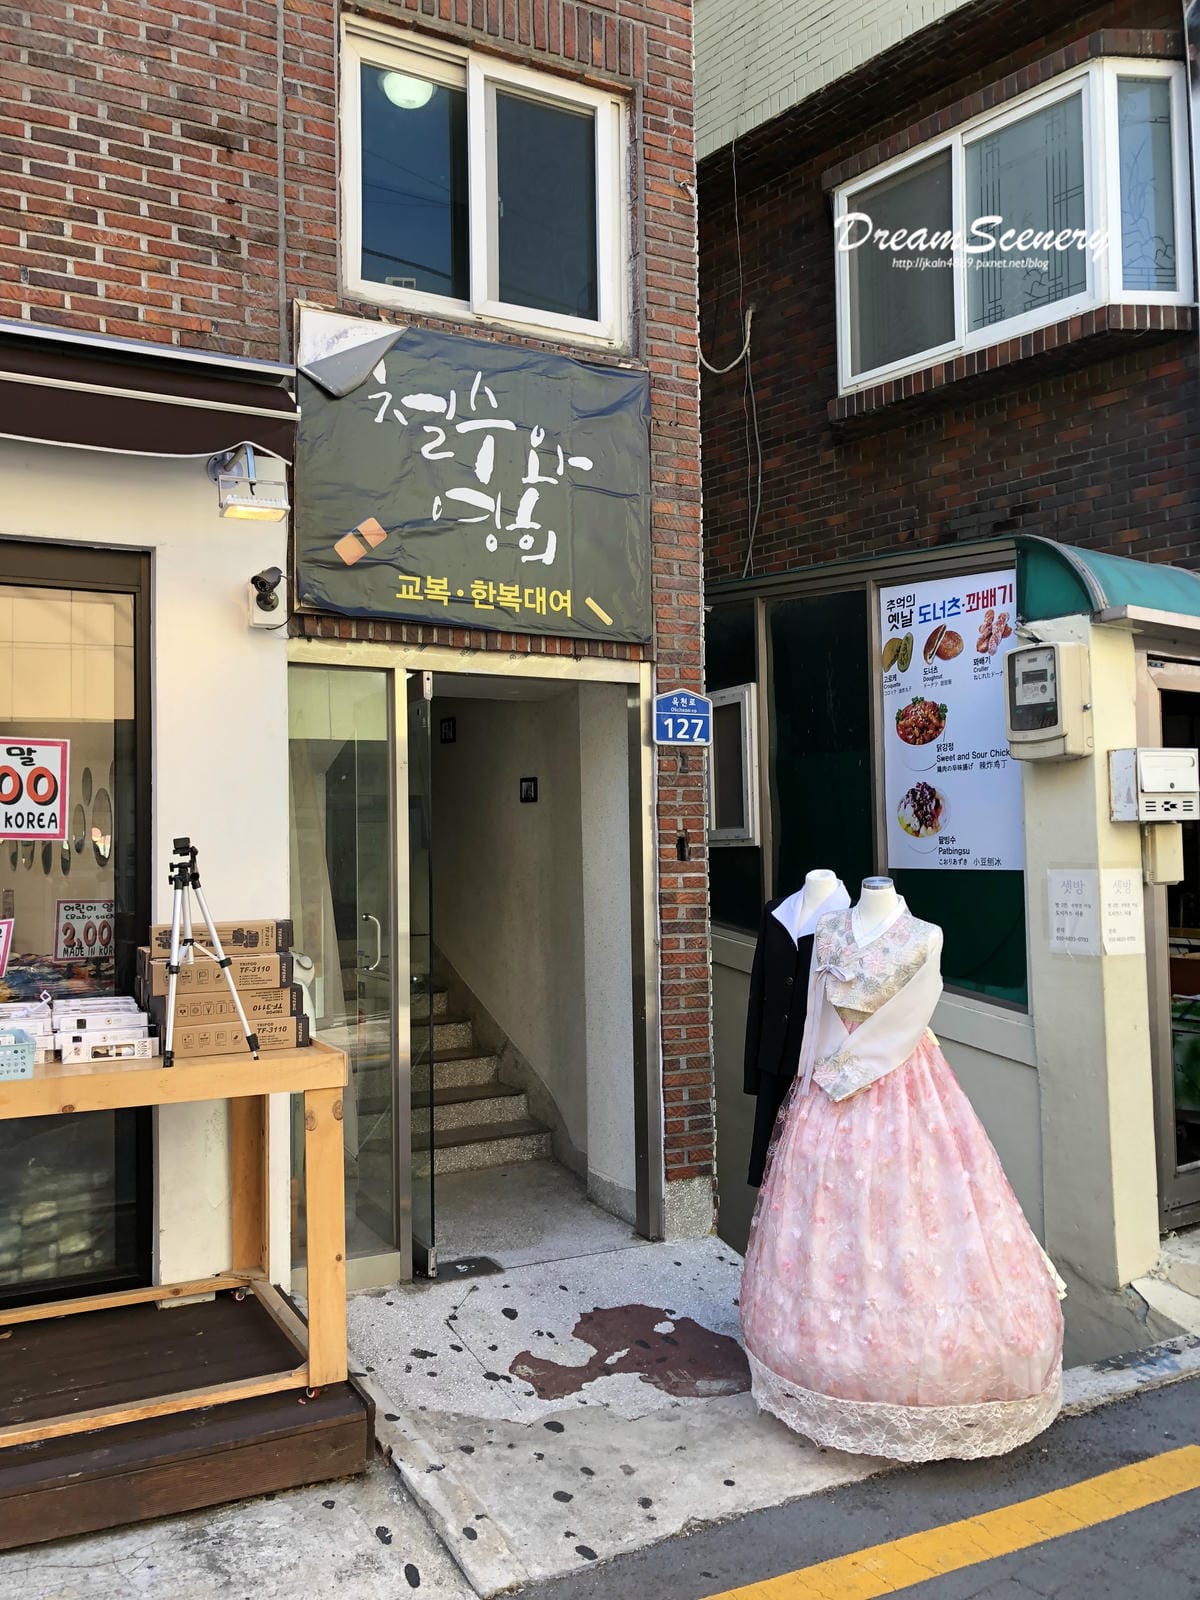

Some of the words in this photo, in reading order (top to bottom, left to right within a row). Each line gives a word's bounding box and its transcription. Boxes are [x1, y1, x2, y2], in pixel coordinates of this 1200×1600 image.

[886, 593, 916, 612] 추억의
[887, 609, 914, 632] 옛날
[671, 696, 696, 708] 옥천로
[663, 718, 704, 739] 127
[936, 753, 956, 763] Sweet
[957, 751, 970, 761] and
[971, 750, 988, 760] Sour
[938, 846, 970, 856] Patbingsu
[63, 946, 85, 957] MADE
[87, 947, 96, 956] IN
[240, 965, 271, 974] TF-3110
[257, 1025, 288, 1035] TF-3110
